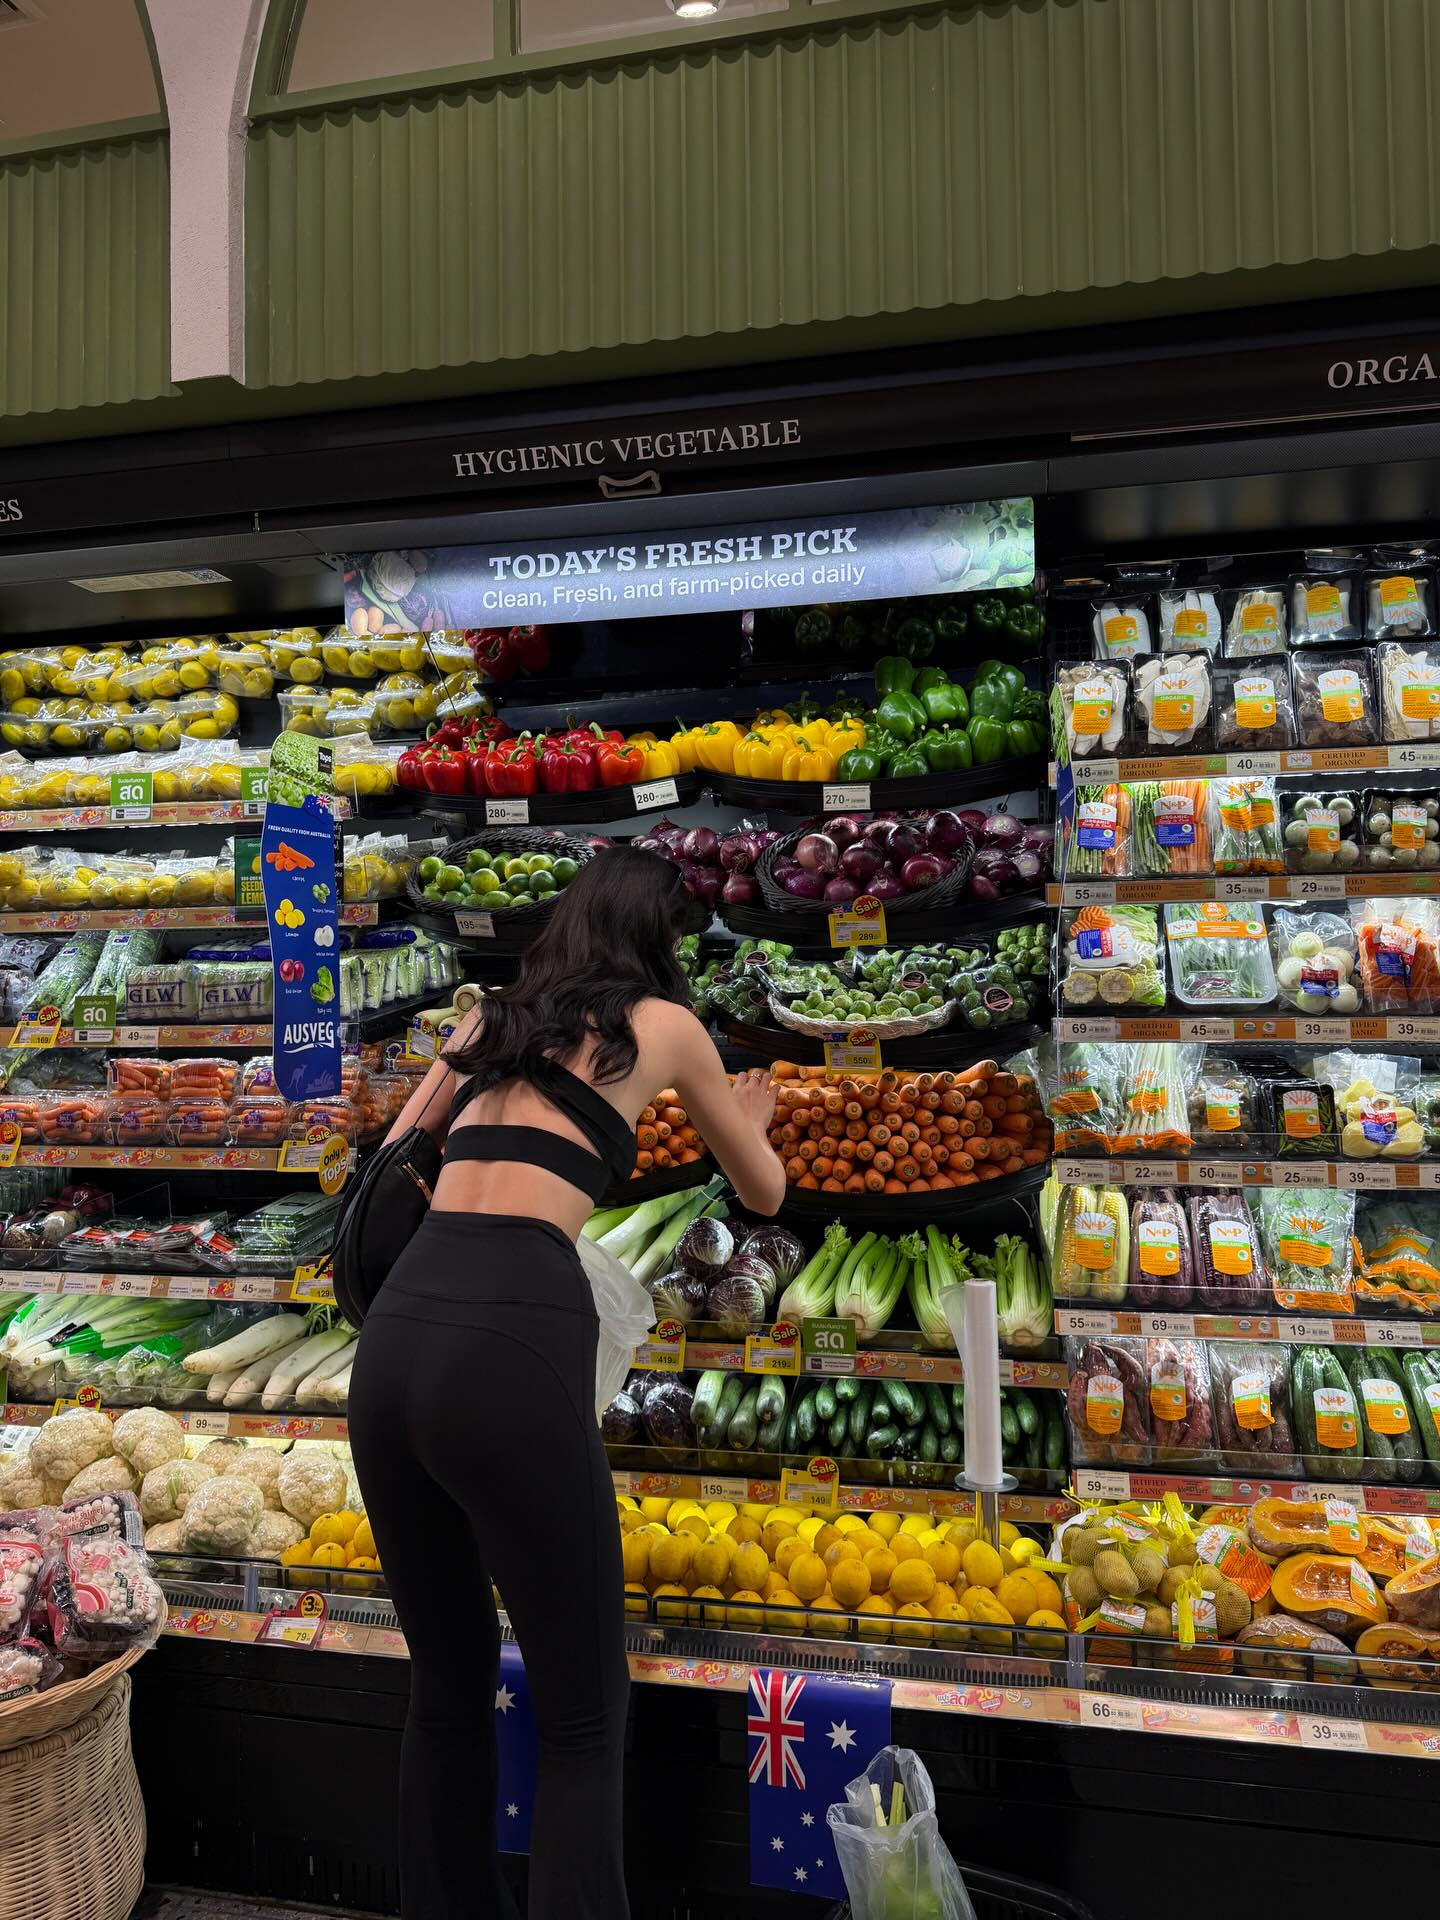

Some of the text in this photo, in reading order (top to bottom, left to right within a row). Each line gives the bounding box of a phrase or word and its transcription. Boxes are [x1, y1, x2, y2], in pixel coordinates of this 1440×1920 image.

[1327, 353, 1440, 389] ORGA
[453, 419, 801, 477] HYGIENIC VEGETABLE
[489, 527, 858, 581] TODAY'S FRESH PICK
[482, 563, 866, 609] Clean, Fresh, and farm-picked daily
[1321, 751, 1366, 760] CERTIFIED
[1399, 751, 1416, 761] 45
[1120, 762, 1163, 770] CERTIFIED
[1237, 759, 1253, 769] 40
[1325, 759, 1362, 767] ORGANIC
[1076, 767, 1091, 778] 48
[1123, 769, 1159, 777] ORGANIC
[636, 792, 655, 804] 280
[825, 793, 845, 805] 270
[488, 808, 506, 818] 280
[1226, 883, 1241, 894] 35
[1301, 881, 1317, 892] 29
[1075, 889, 1090, 899] 55
[855, 900, 880, 915] Sale
[459, 920, 475, 930] 195
[39, 1009, 60, 1025] Sale
[1072, 1023, 1087, 1033] 69
[1190, 1024, 1206, 1035] 45
[1305, 1024, 1320, 1034] 39
[1398, 1024, 1414, 1034] 39
[128, 1032, 139, 1041] 49
[283, 1021, 335, 1047] AUSVEG
[851, 1032, 876, 1046] Sale
[308, 1131, 330, 1144] Sale
[324, 1149, 340, 1166] Only
[322, 1157, 347, 1185] Tops
[1066, 1168, 1081, 1178] 25
[1135, 1167, 1150, 1178] 22
[1200, 1168, 1215, 1178] 50
[1284, 1172, 1300, 1183] 25
[1350, 1172, 1364, 1183] 39
[120, 1281, 131, 1291] 59
[242, 1283, 254, 1293] 45
[1070, 1317, 1085, 1328] 55
[1152, 1319, 1167, 1330] 69
[658, 1325, 683, 1339] Sale
[772, 1326, 798, 1341] Sale
[1290, 1324, 1305, 1335] 19
[1378, 1329, 1393, 1340] 36
[815, 1331, 844, 1349] สด
[658, 1355, 672, 1364] 419
[771, 1359, 787, 1368] 219
[79, 1391, 99, 1404] Sale
[196, 1419, 208, 1429] 99
[810, 1462, 837, 1476] Sale
[704, 1484, 723, 1495] 159
[1087, 1480, 1101, 1491] 59
[305, 1595, 315, 1612] 3
[1105, 1616, 1135, 1631] ORGANIC
[295, 1632, 307, 1641] 79
[975, 1688, 994, 1702] 20
[1092, 1702, 1110, 1717] 66
[1312, 1724, 1331, 1739] 39
